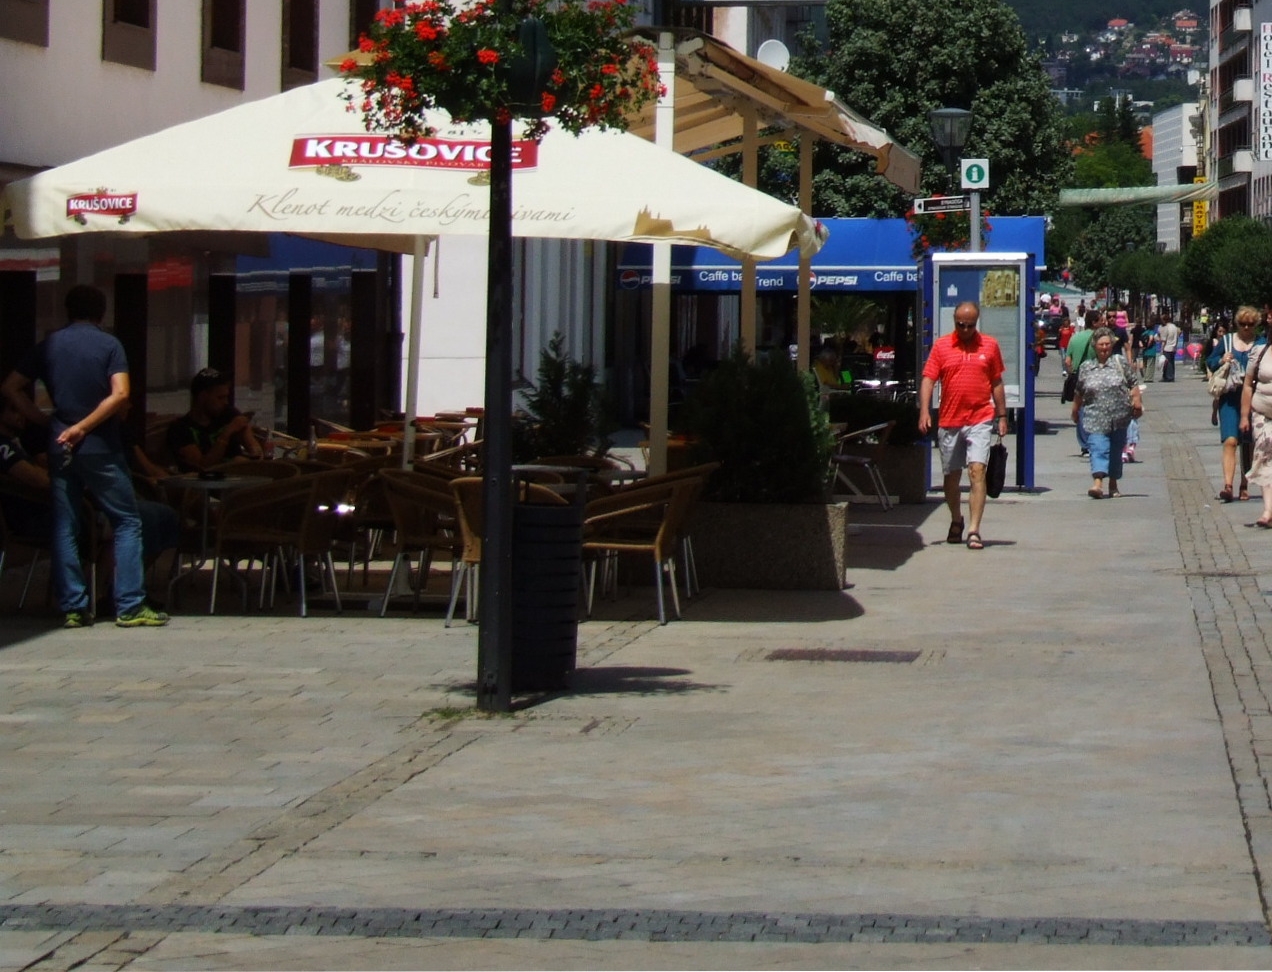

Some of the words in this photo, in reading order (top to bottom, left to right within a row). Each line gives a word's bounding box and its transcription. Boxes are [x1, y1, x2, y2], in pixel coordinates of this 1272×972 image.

[70, 196, 133, 210] KRUŠOVICE
[247, 188, 330, 220] Klenot
[336, 189, 402, 223] medzi
[511, 206, 576, 222] ivami
[641, 275, 681, 285] PSI
[699, 270, 728, 282] Caffe
[817, 275, 859, 286] PEPSI
[874, 271, 903, 282] Caffe
[907, 271, 923, 282] ba
